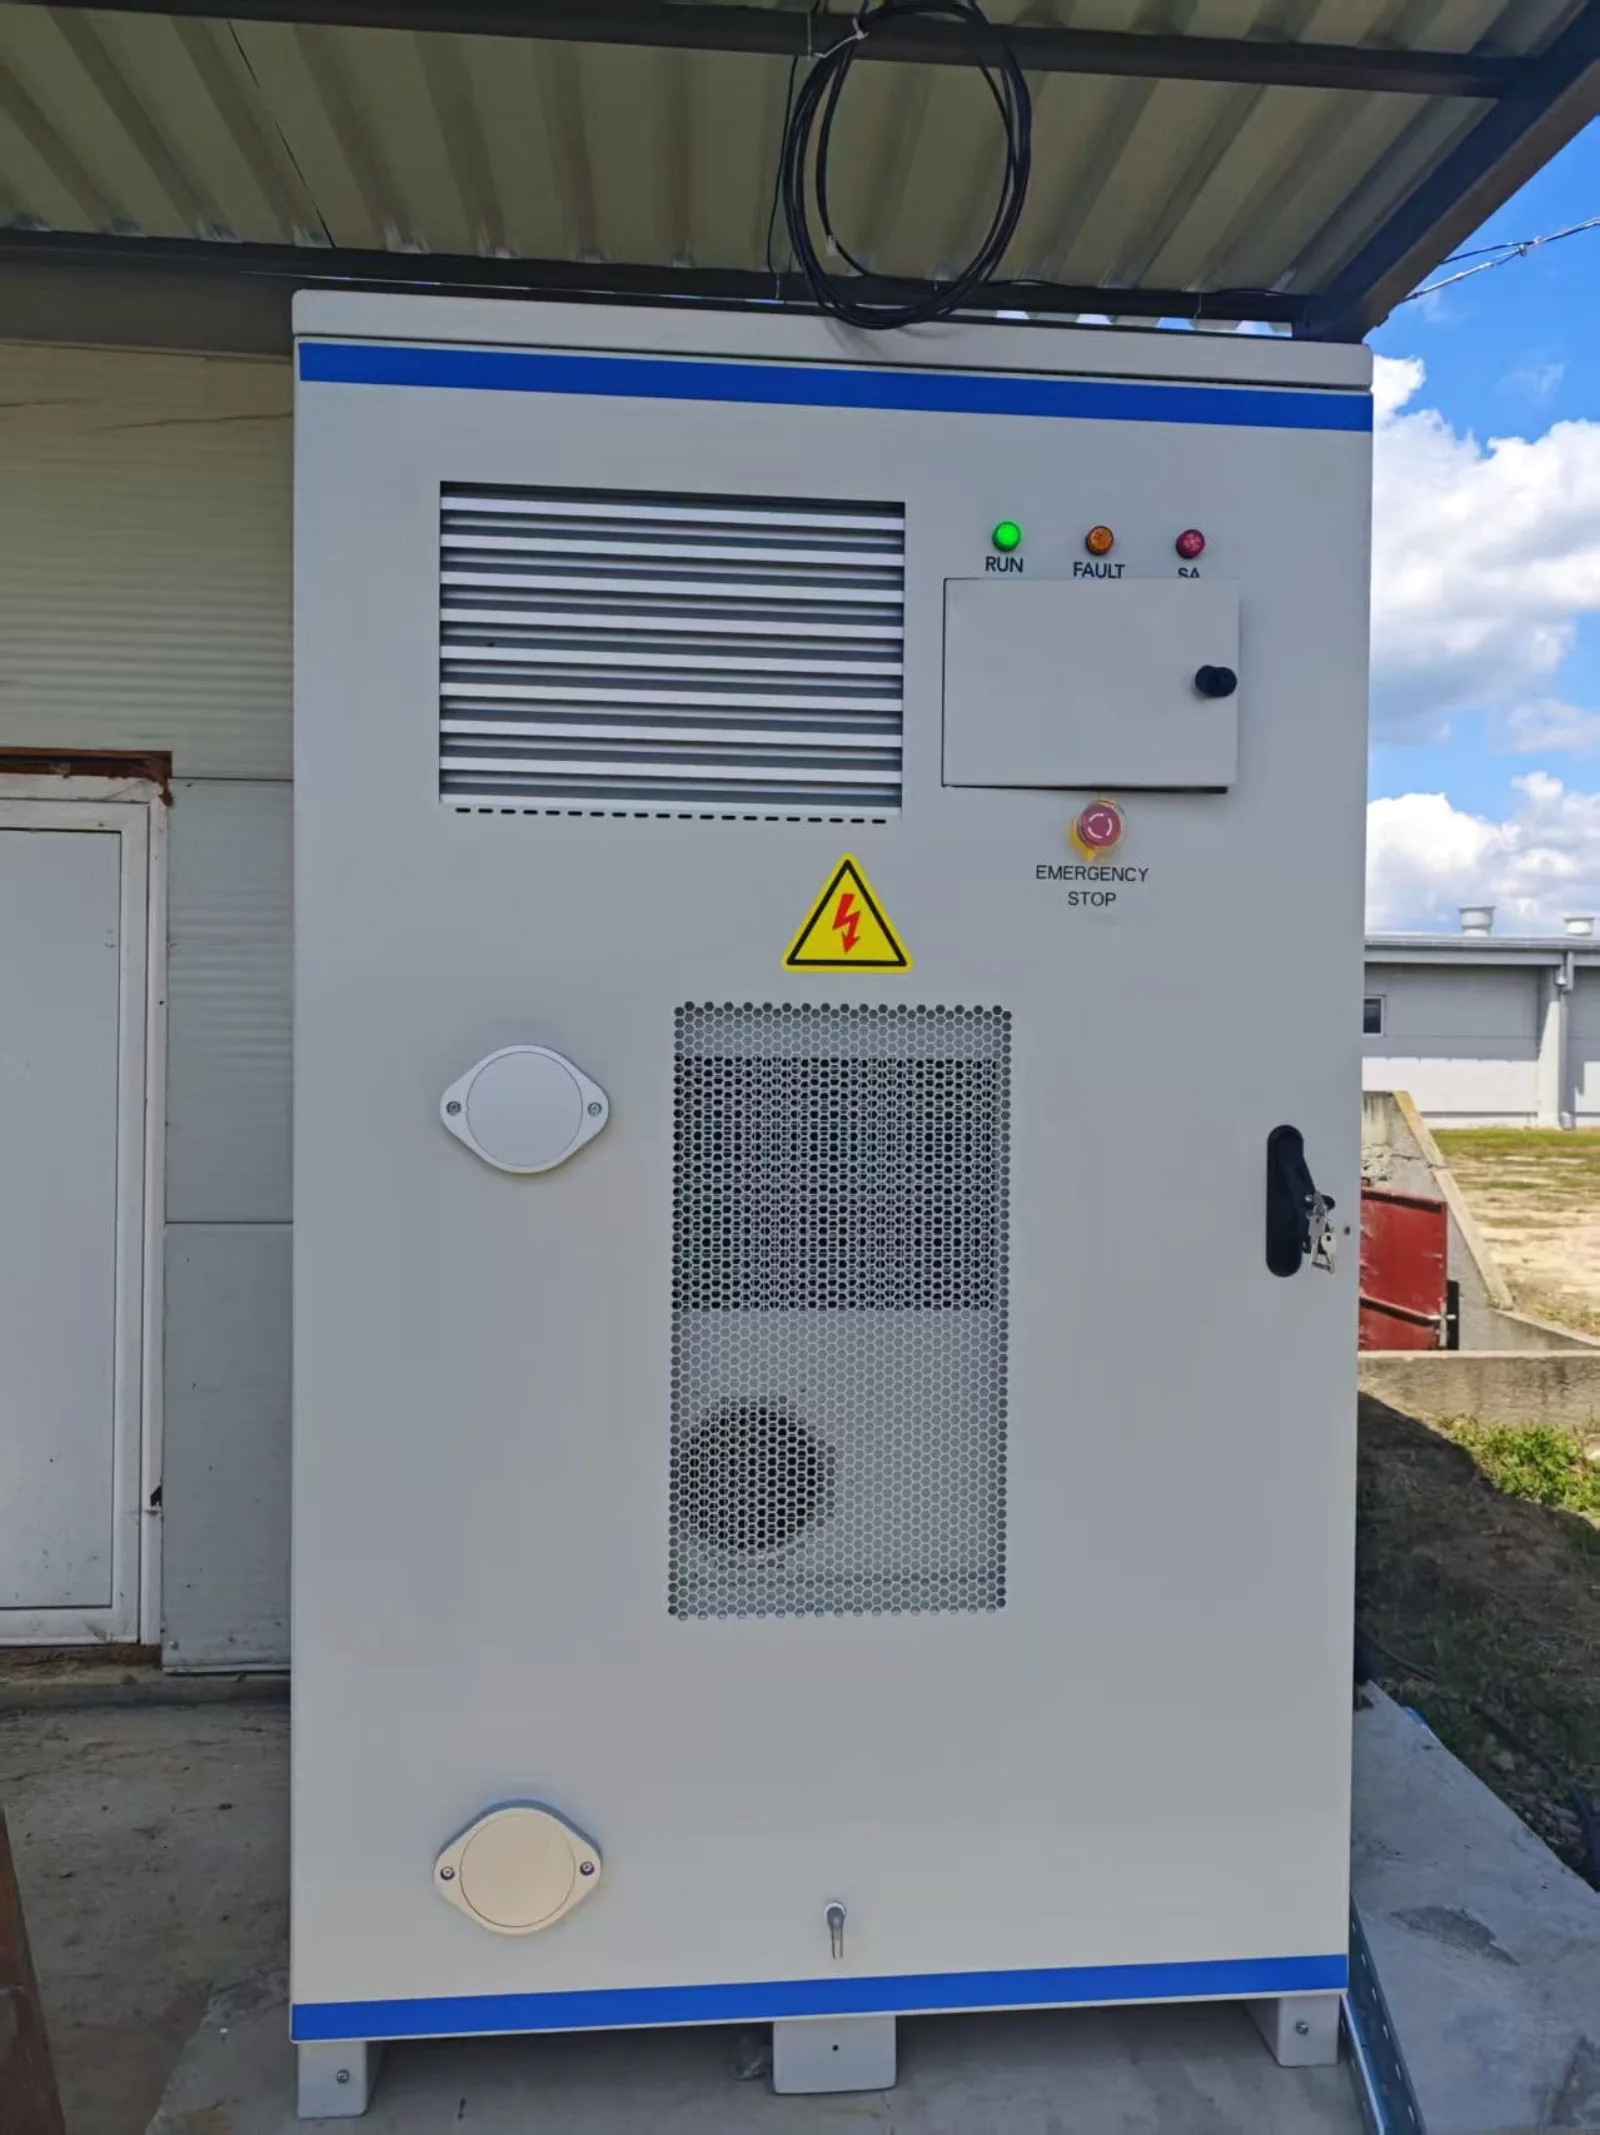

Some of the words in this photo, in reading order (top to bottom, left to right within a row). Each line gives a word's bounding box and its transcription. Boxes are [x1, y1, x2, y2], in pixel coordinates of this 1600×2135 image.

[985, 556, 1024, 573] RUN
[1073, 561, 1126, 579] FAULT
[1036, 864, 1149, 882] EMERGENCY
[1067, 891, 1117, 907] STOP
